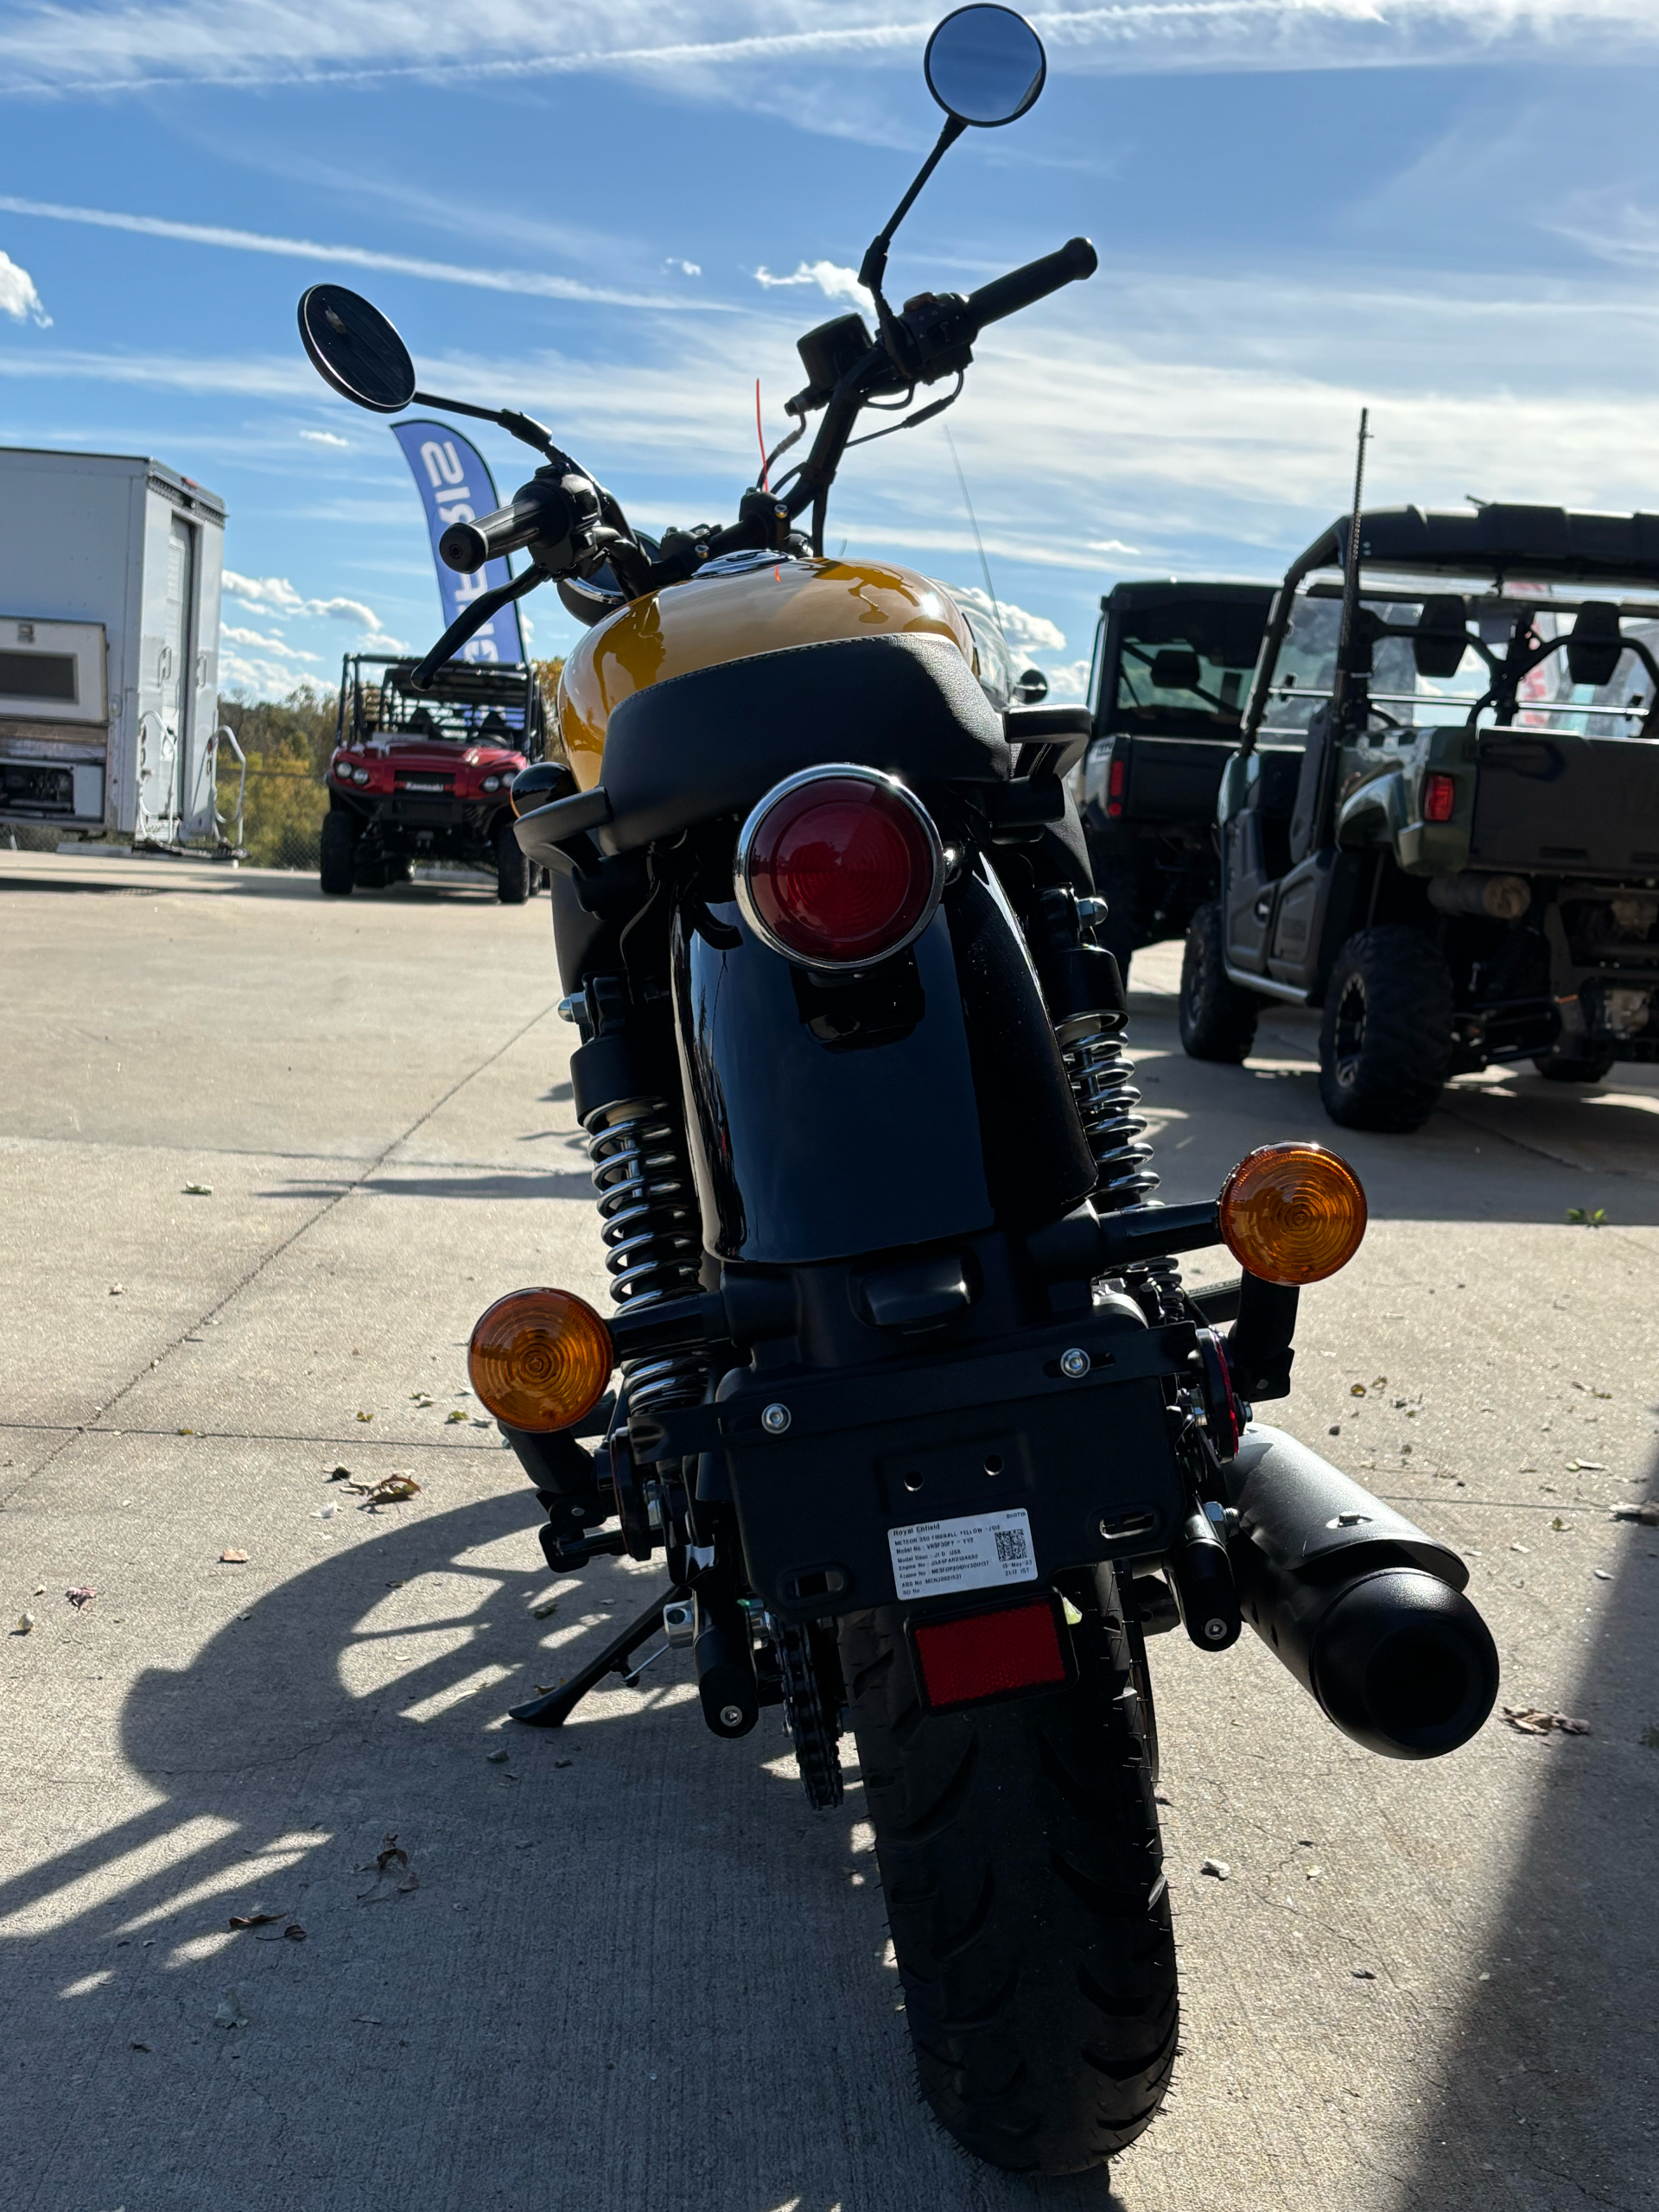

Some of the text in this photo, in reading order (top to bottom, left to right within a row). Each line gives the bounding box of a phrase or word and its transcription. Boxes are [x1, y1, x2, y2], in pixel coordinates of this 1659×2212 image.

[404, 781, 444, 793] Kawasaki
[893, 1523, 940, 1537] Royal Enfield
